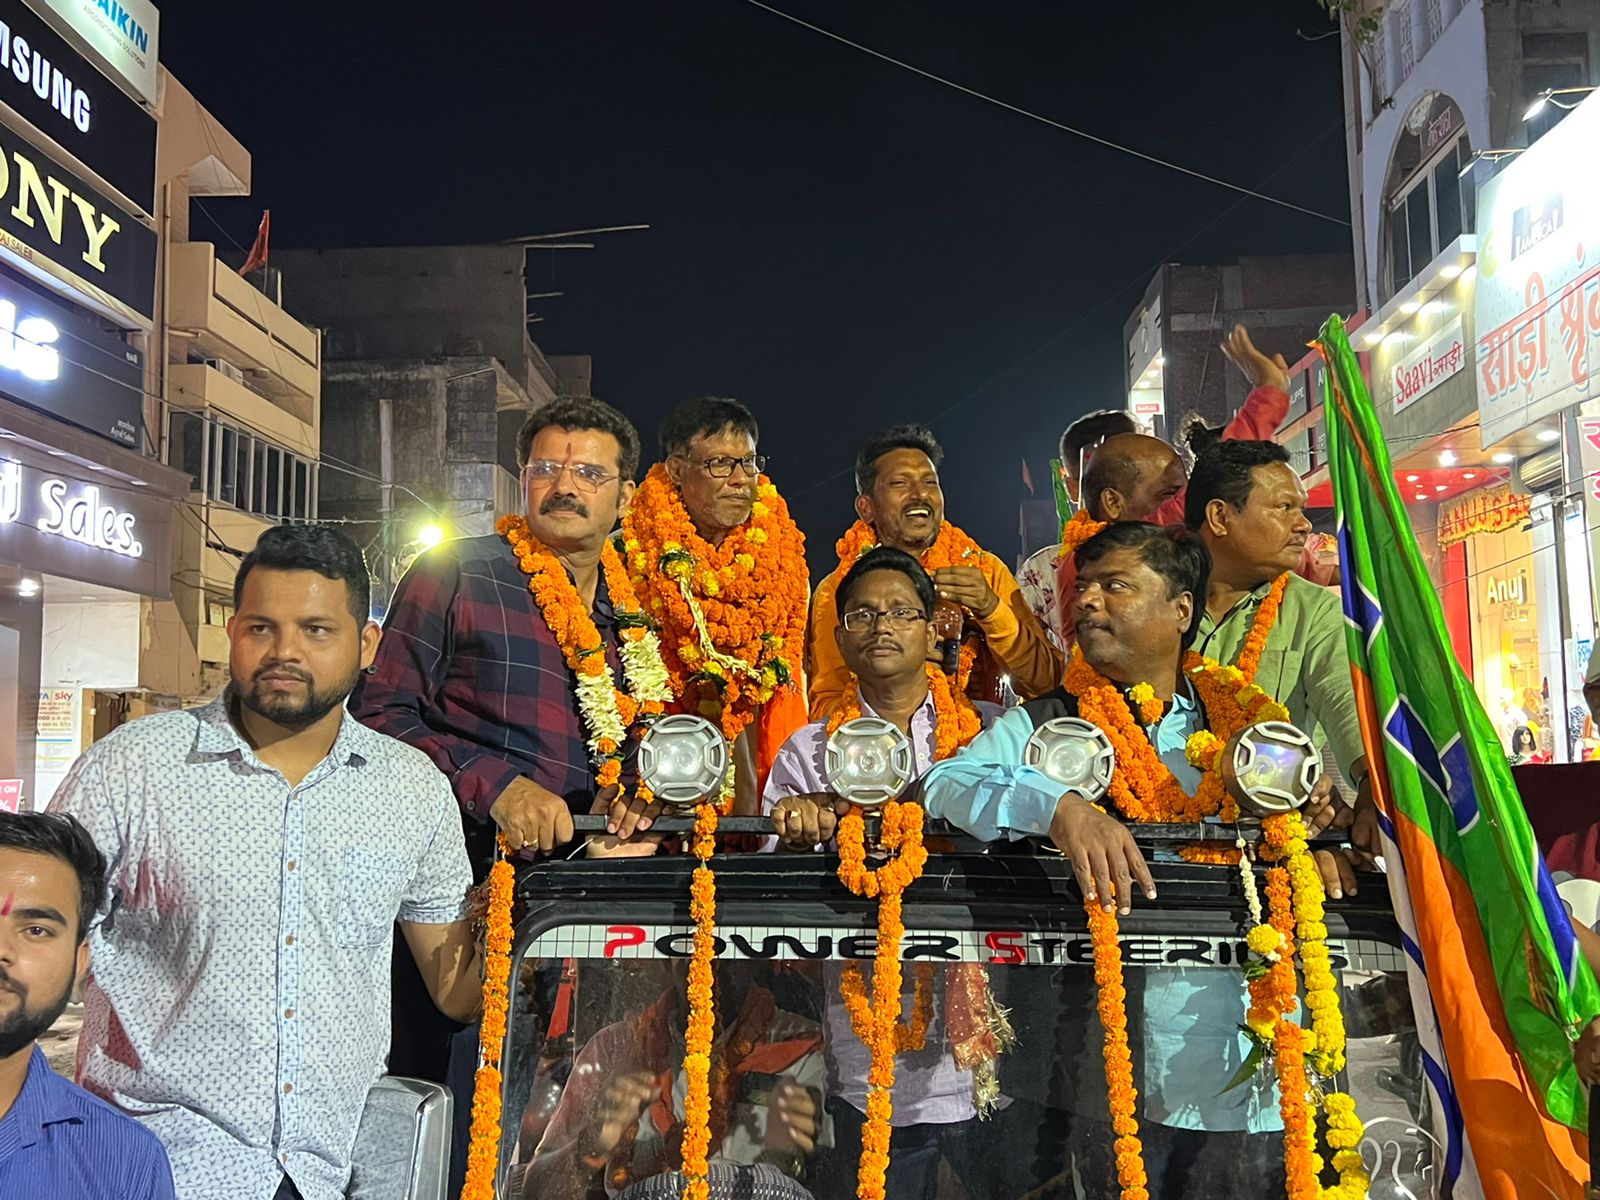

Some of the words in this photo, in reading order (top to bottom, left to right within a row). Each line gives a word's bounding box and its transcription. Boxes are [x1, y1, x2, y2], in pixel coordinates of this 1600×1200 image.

[92, 0, 148, 54] AIKIN
[0, 145, 121, 273] NY
[0, 233, 11, 246] AJ
[11, 239, 33, 260] SALES
[1480, 272, 1548, 396] साड़ी
[1487, 569, 1524, 606] Anuj
[54, 690, 73, 702] sky
[603, 925, 962, 961] POWER
